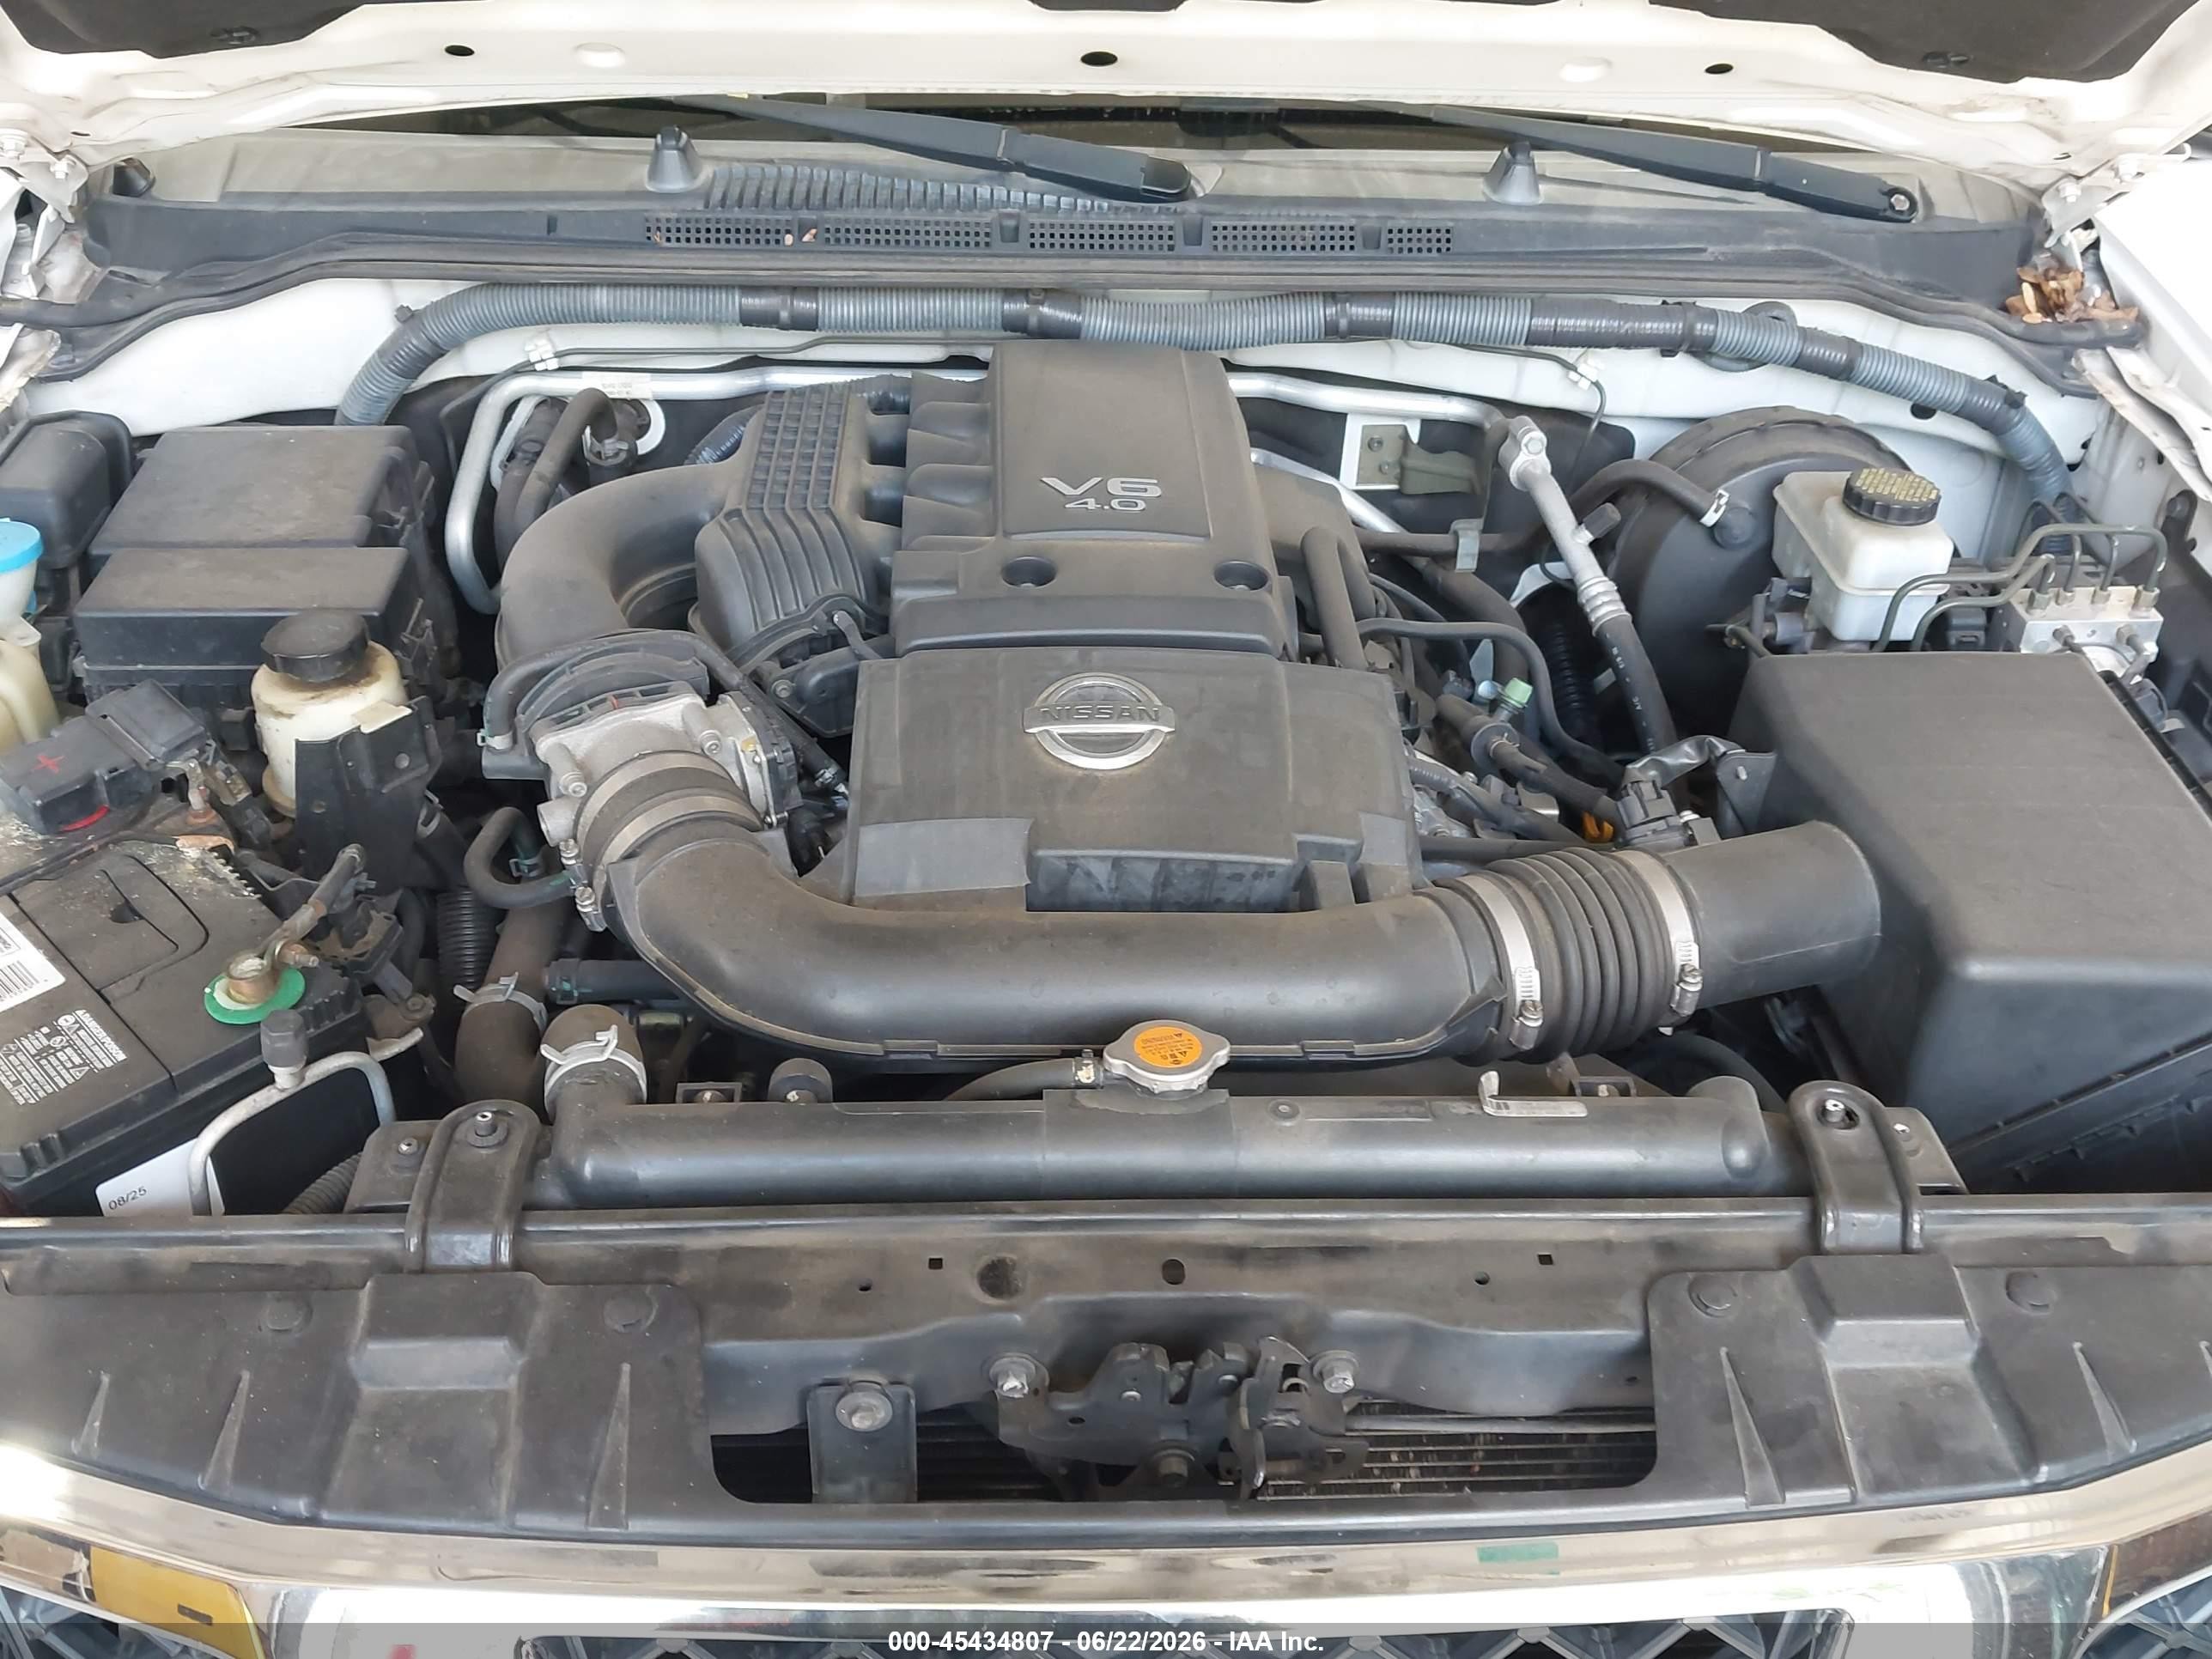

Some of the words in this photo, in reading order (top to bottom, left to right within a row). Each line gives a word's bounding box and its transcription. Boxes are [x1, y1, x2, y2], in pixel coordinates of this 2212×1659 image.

[1040, 477, 1162, 497] V6
[1065, 498, 1146, 511] 4.0
[1039, 704, 1160, 721] NISSAN
[108, 1186, 148, 1210] 08/25
